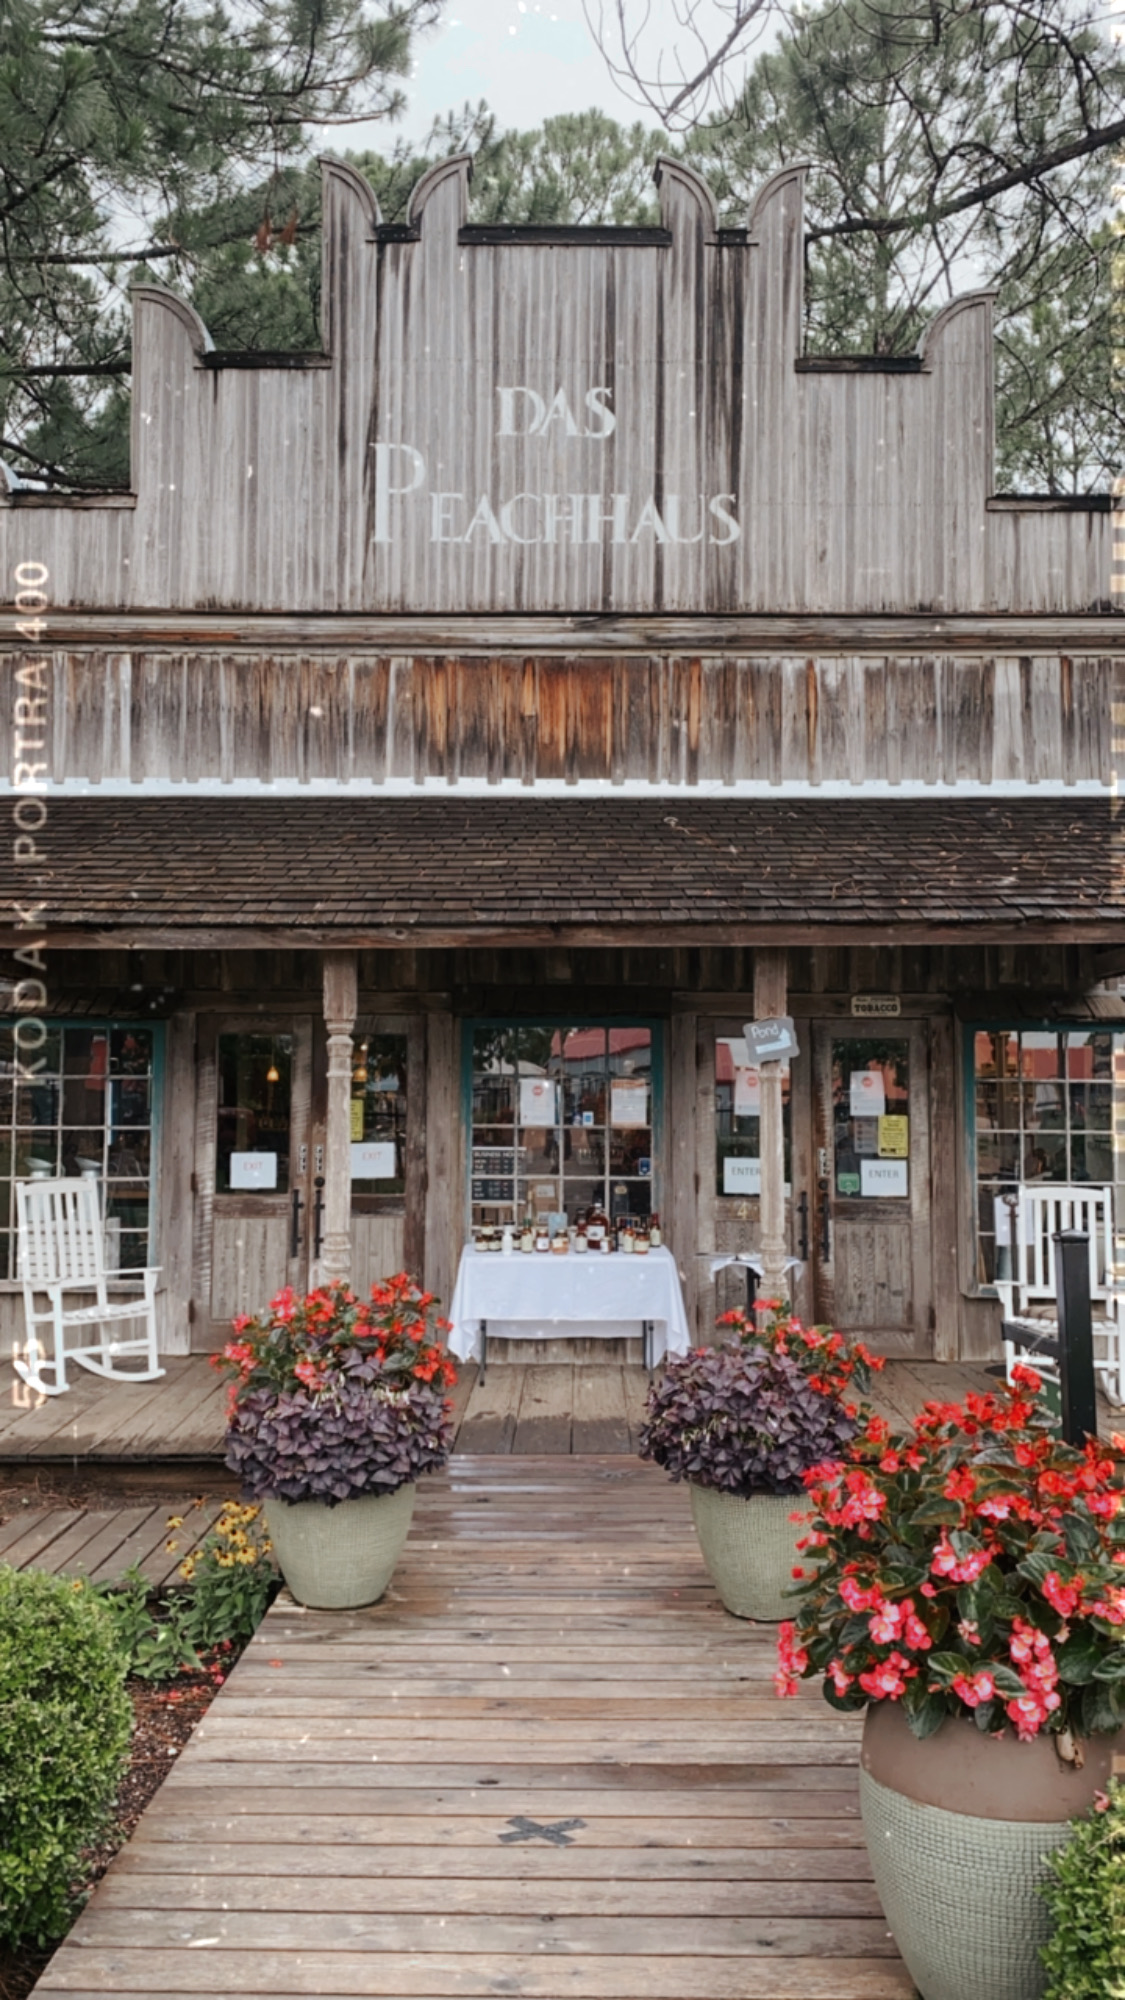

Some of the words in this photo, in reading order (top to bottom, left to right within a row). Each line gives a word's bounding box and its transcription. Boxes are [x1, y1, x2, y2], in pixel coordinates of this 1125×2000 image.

[496, 386, 617, 439] DAS
[368, 442, 741, 546] PEACHHAUS
[854, 1004, 898, 1013] TOBACCO
[751, 1022, 779, 1039] Pond
[362, 1151, 382, 1161] EXIT
[243, 1161, 263, 1170] EXIT
[868, 1169, 899, 1179] ENTER
